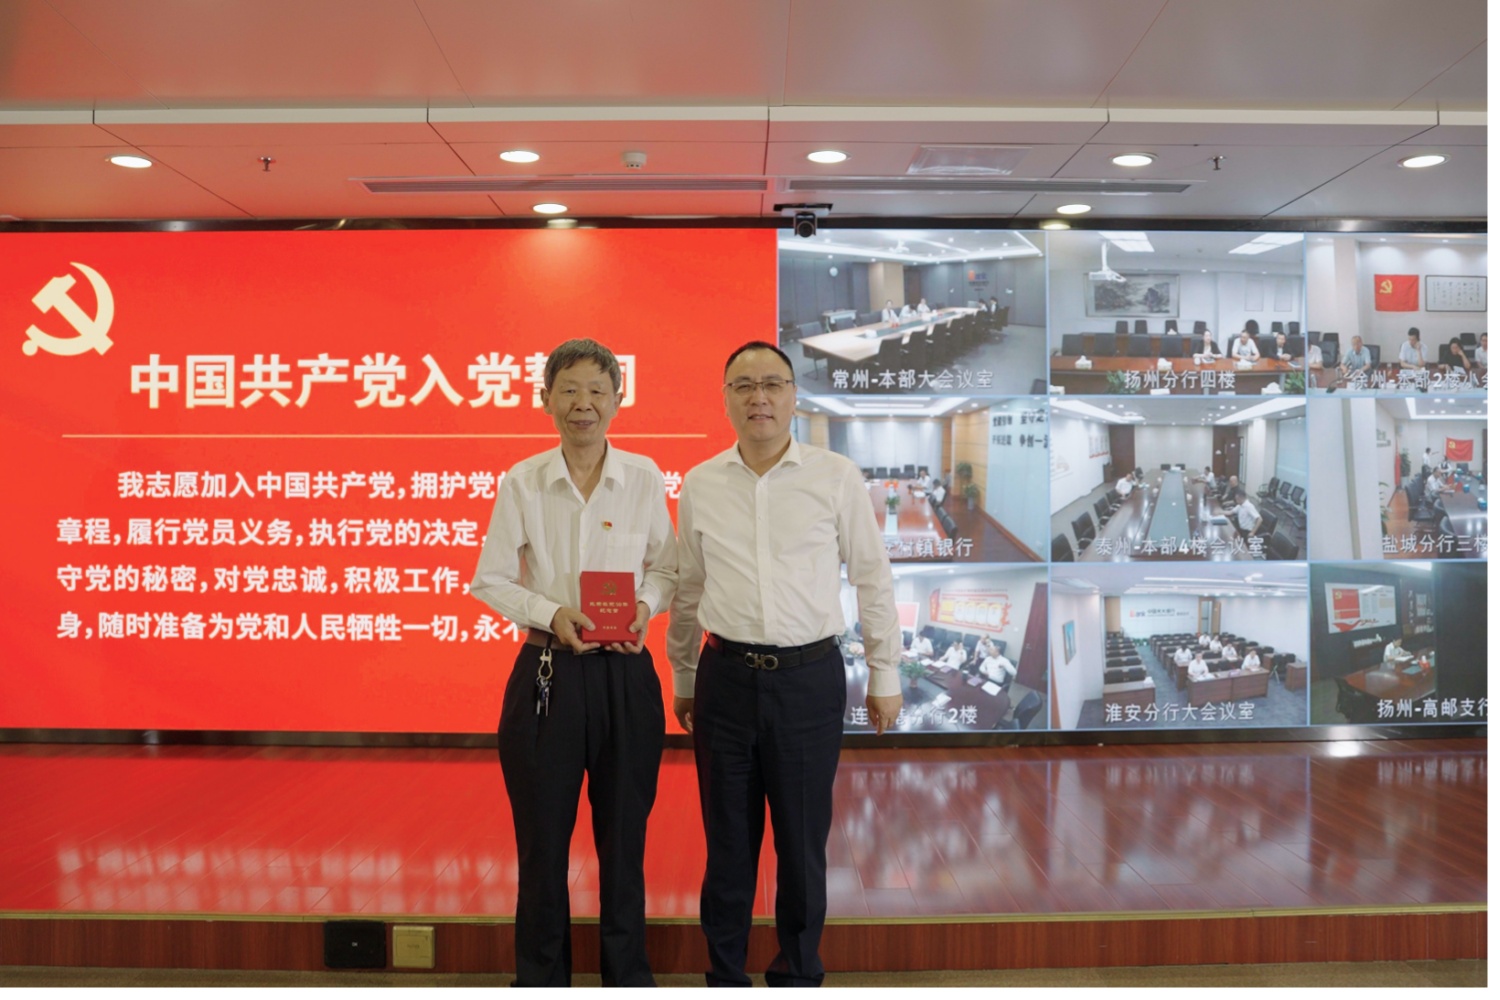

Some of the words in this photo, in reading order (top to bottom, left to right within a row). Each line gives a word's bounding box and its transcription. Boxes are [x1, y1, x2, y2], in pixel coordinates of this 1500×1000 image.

[831, 368, 993, 390] 常州-本部大会议室
[1123, 369, 1236, 390] 扬州分行四楼
[117, 470, 505, 500] 我志愿加入中国共产党，拥护党
[1105, 701, 1256, 723] 淮安分行大会议室
